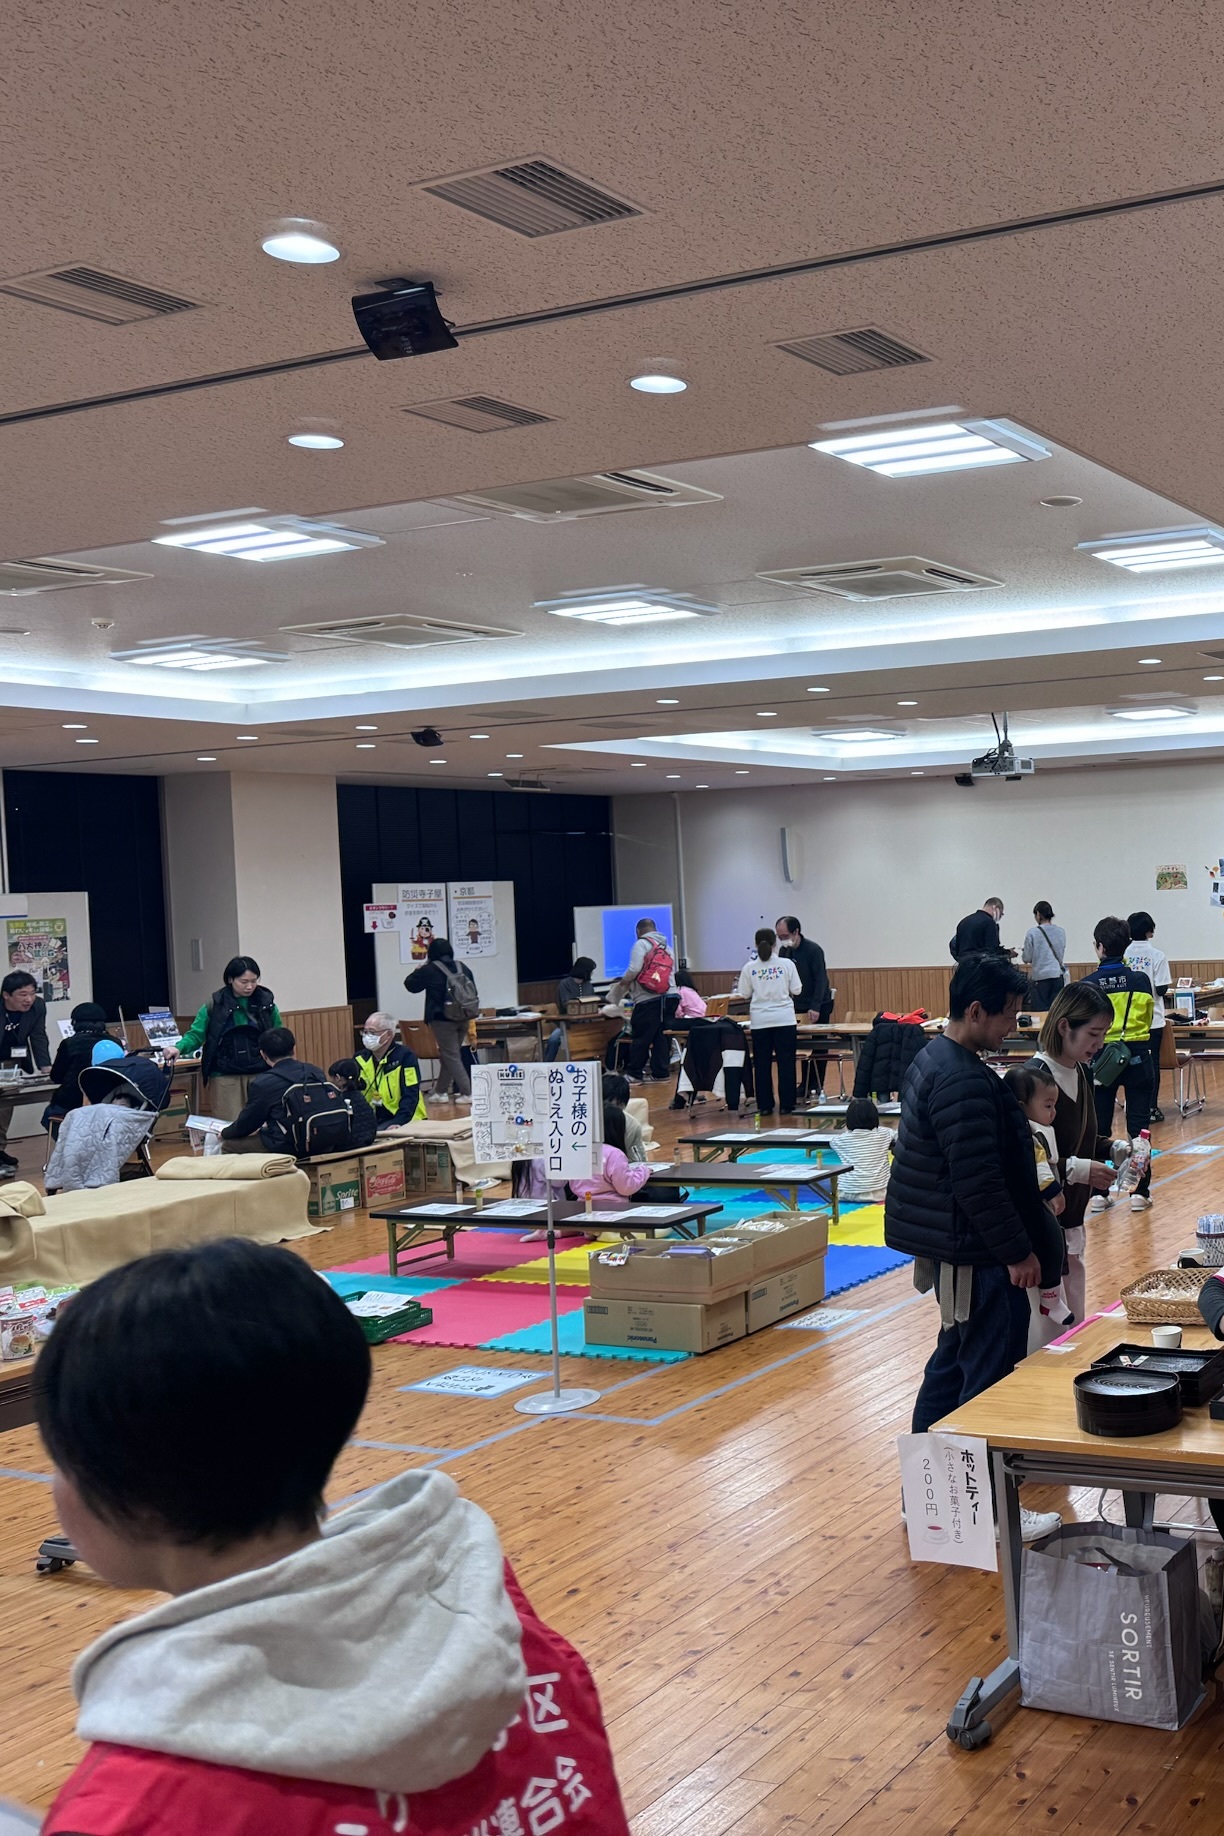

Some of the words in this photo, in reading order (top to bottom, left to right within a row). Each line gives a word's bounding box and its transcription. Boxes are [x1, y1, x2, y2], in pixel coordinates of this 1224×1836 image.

[1098, 976, 1127, 986] 京都市
[548, 1068, 565, 1172] ぬりえ入り口
[571, 1067, 588, 1137] お子様の
[626, 1334, 657, 1344] Panasonic
[922, 1458, 939, 1517] 200円
[943, 1446, 964, 1545] (小さなお菓子付き)
[960, 1448, 980, 1526] ホットティー
[1143, 1594, 1153, 1649] HEUREUSEMENT
[1119, 1611, 1143, 1701] SORTIR
[1111, 1682, 1120, 1713] LUMINEUX
